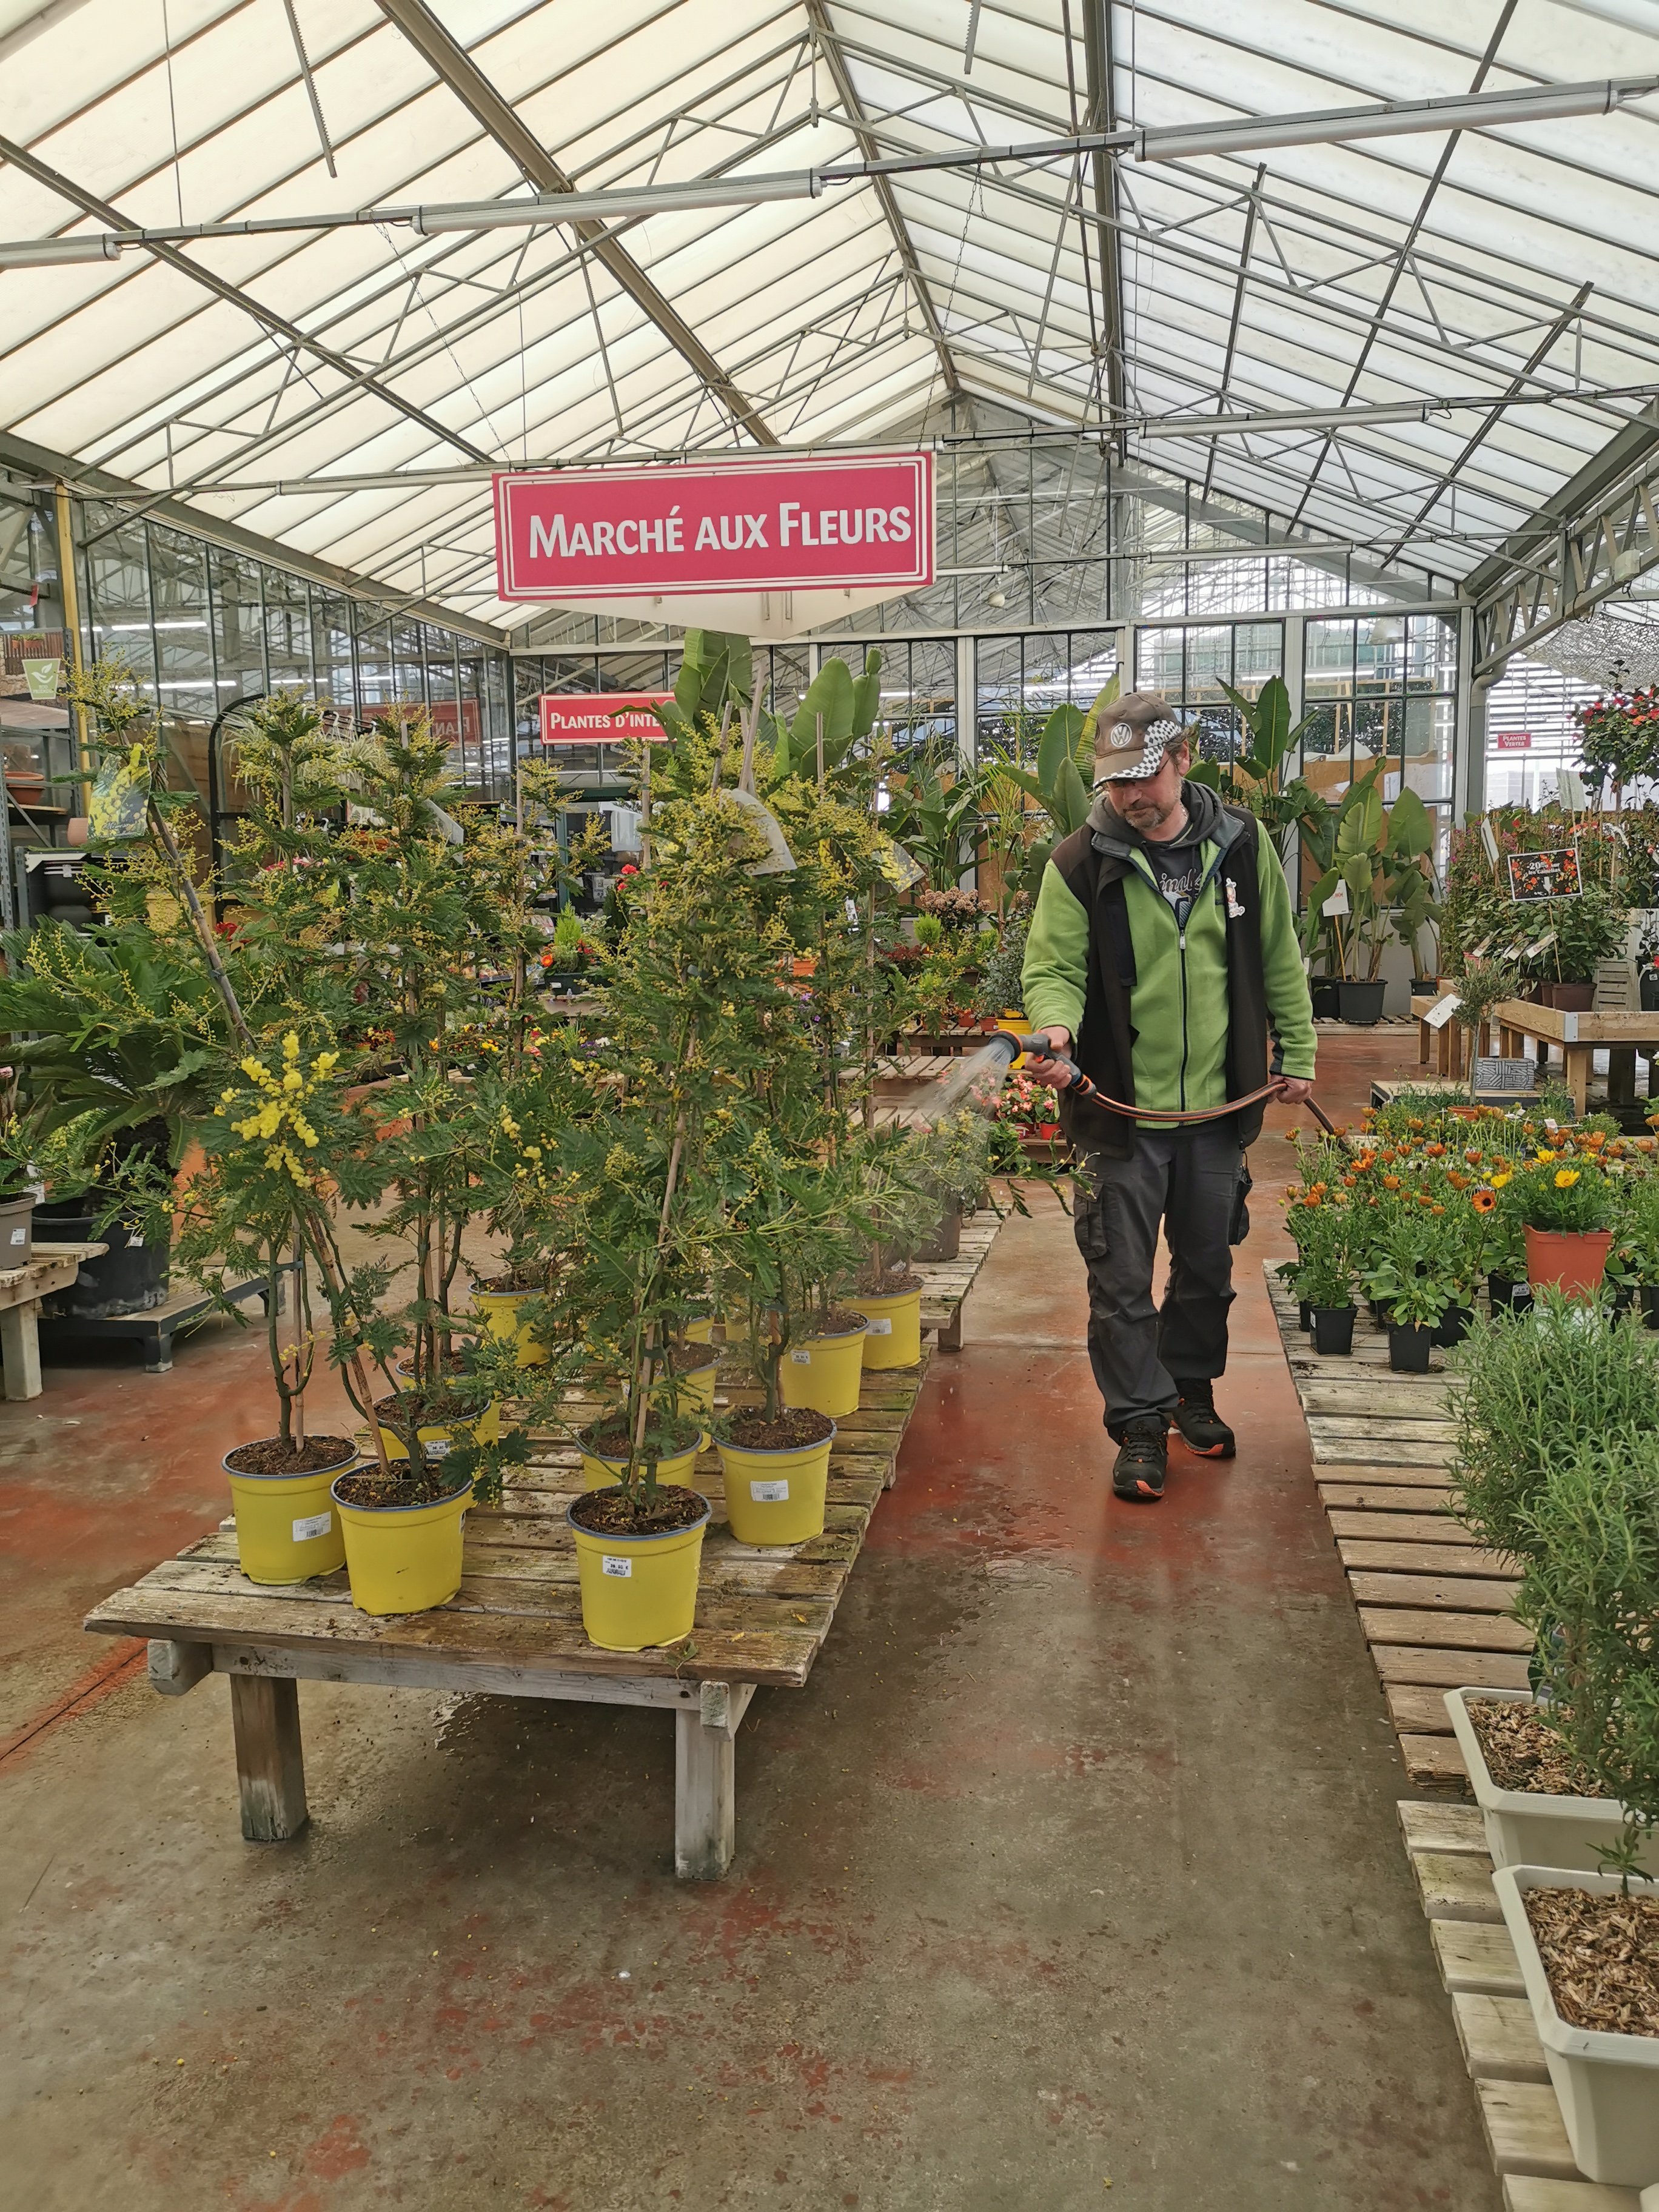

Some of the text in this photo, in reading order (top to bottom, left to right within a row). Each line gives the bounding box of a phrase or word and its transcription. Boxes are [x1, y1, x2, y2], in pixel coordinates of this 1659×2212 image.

[529, 502, 911, 558] MARCHÉ AUX FLEURS
[551, 712, 611, 729] PLANTES
